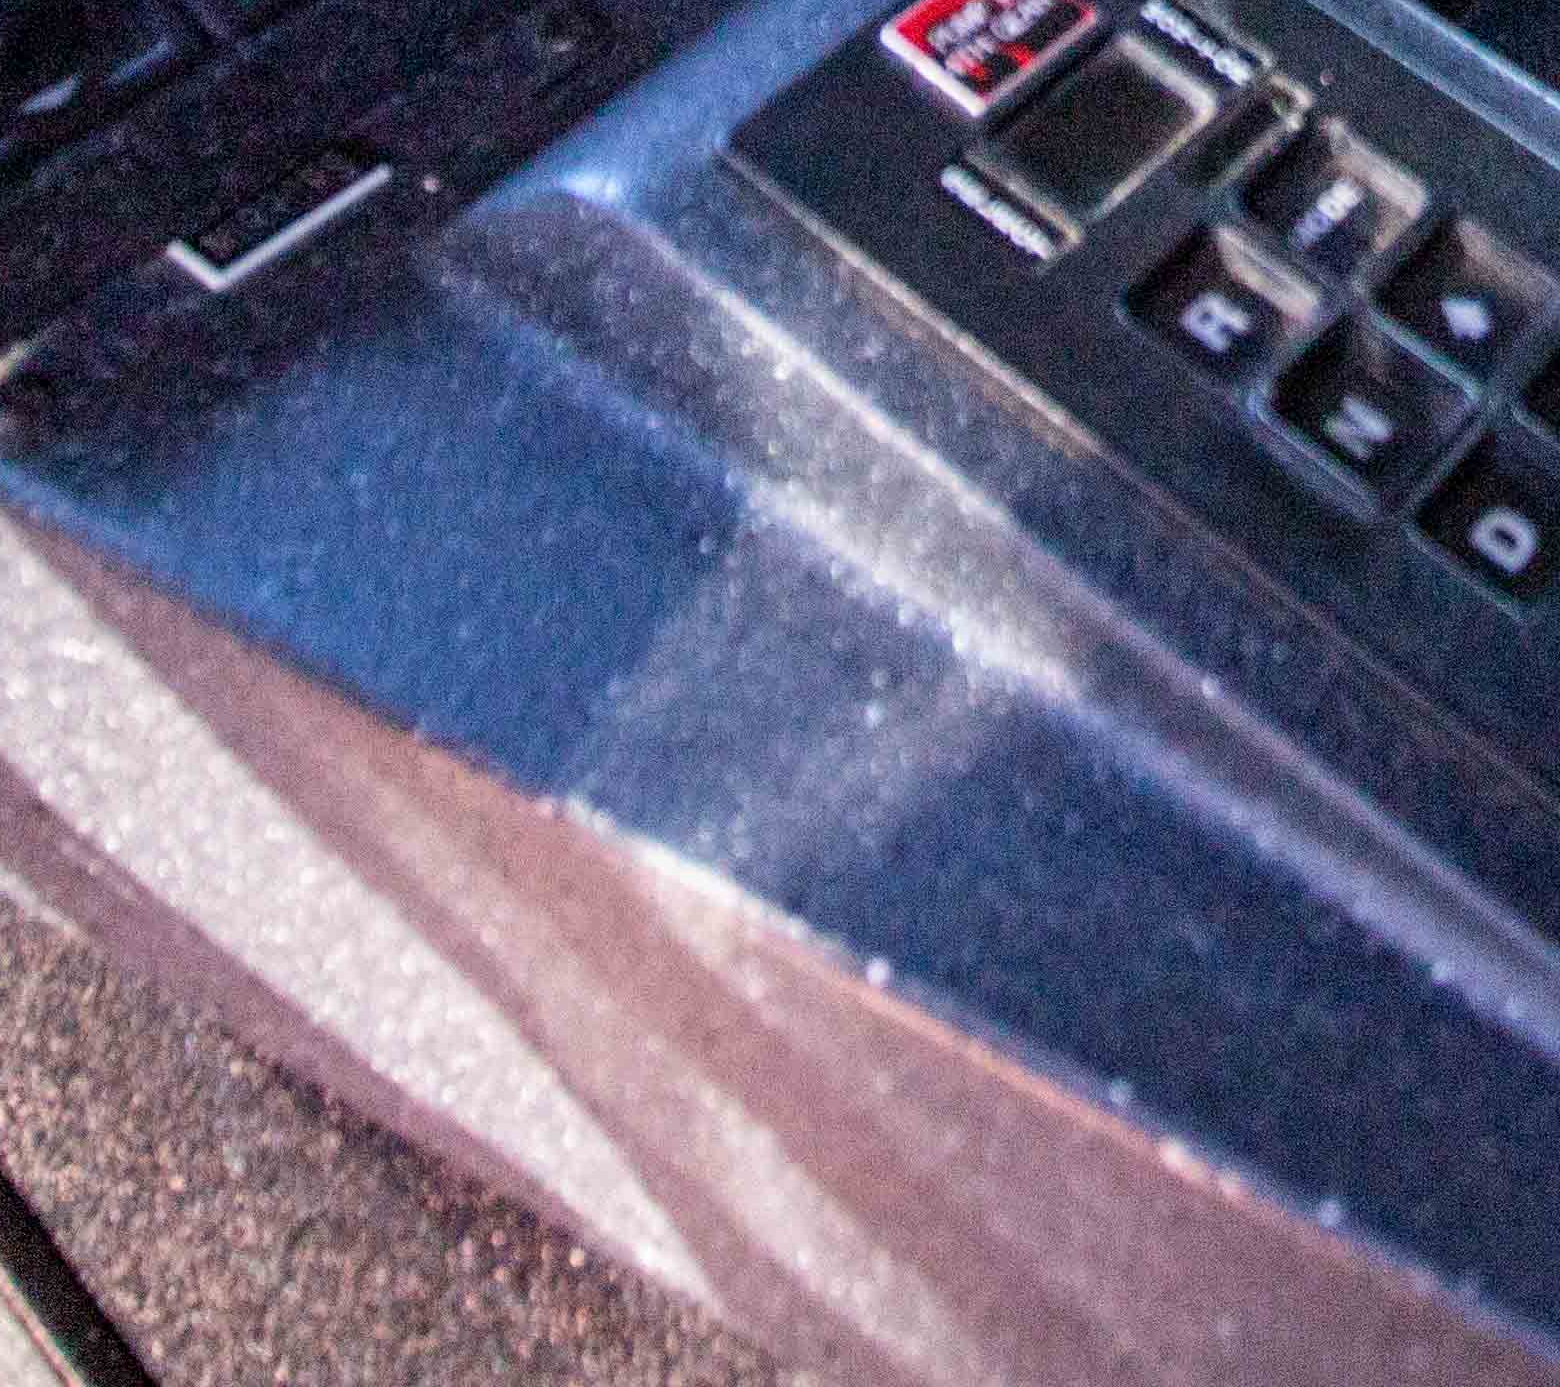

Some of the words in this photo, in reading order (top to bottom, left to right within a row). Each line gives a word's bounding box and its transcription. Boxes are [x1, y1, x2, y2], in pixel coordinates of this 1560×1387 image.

[1181, 291, 1252, 354] R
[1324, 395, 1396, 462] N
[1468, 507, 1539, 574] D
